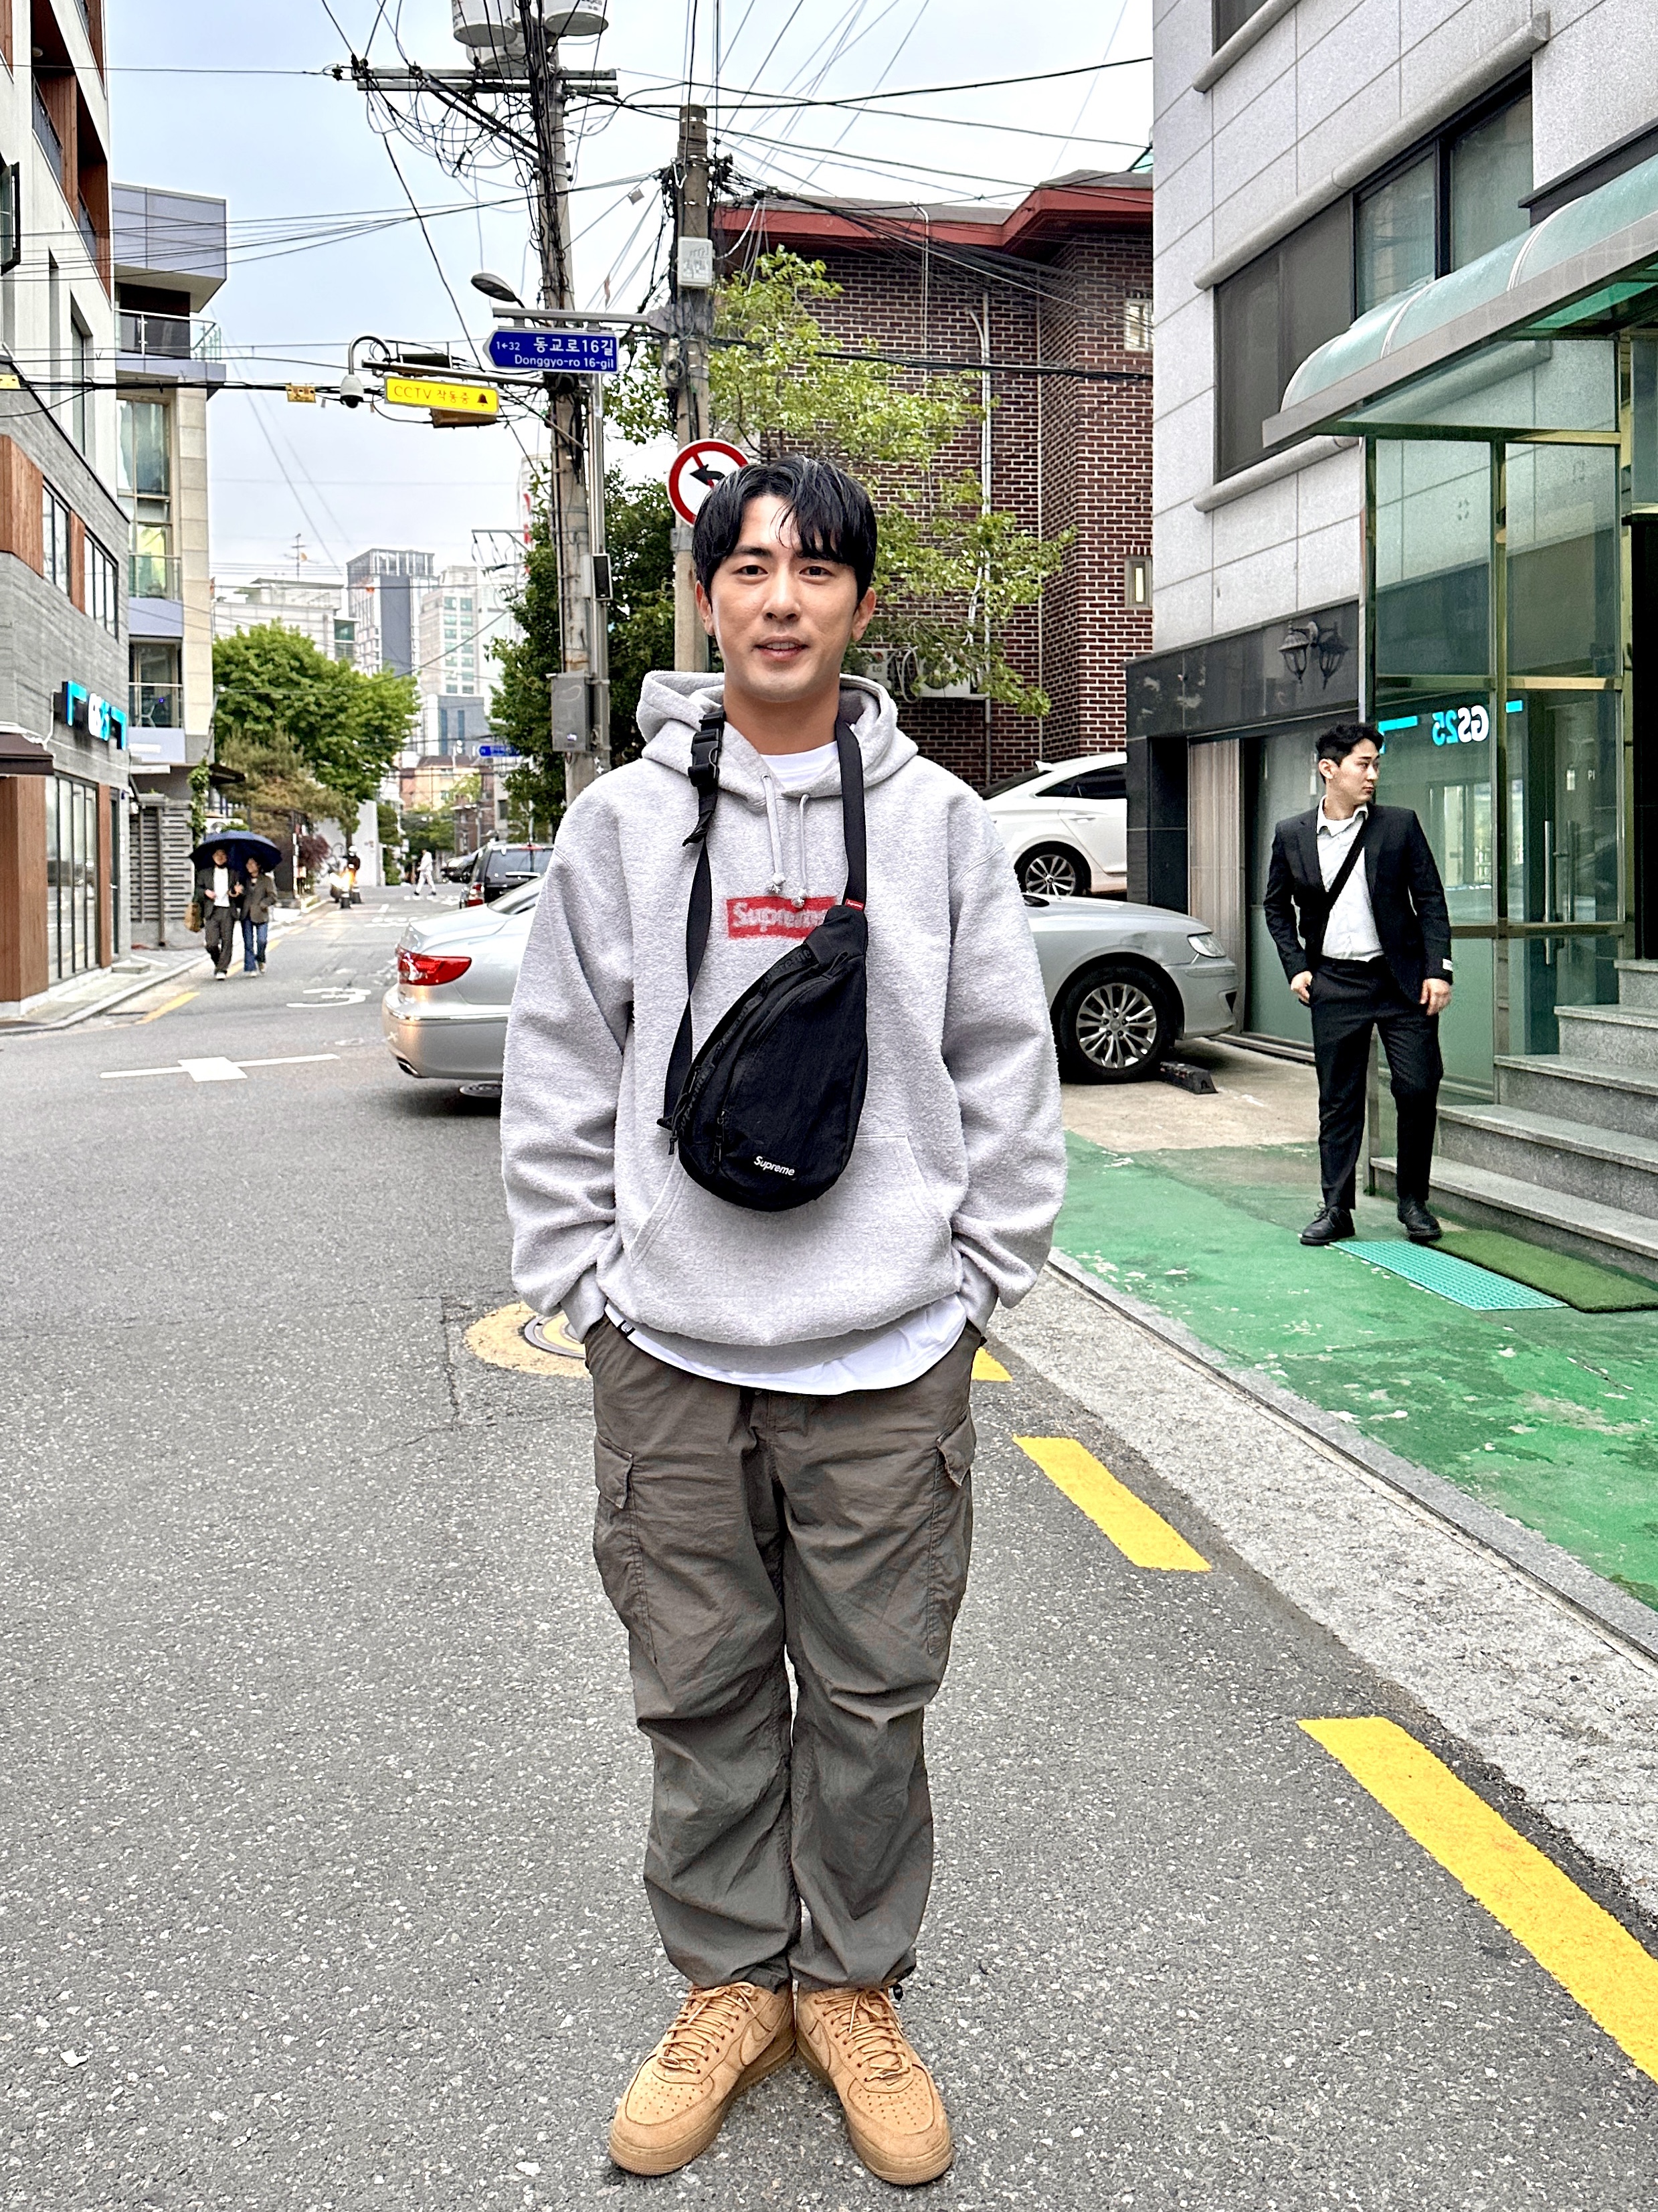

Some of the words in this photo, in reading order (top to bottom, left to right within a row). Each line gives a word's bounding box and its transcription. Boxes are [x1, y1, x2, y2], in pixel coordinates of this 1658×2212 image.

[533, 337, 614, 356] 동교로16길
[515, 355, 580, 367] Donggyo-ro
[583, 357, 614, 369] 16-gil
[394, 386, 432, 400] CCTV
[437, 390, 470, 405] 작동중
[872, 665, 883, 673] LG
[753, 1155, 795, 1176] Supreme
